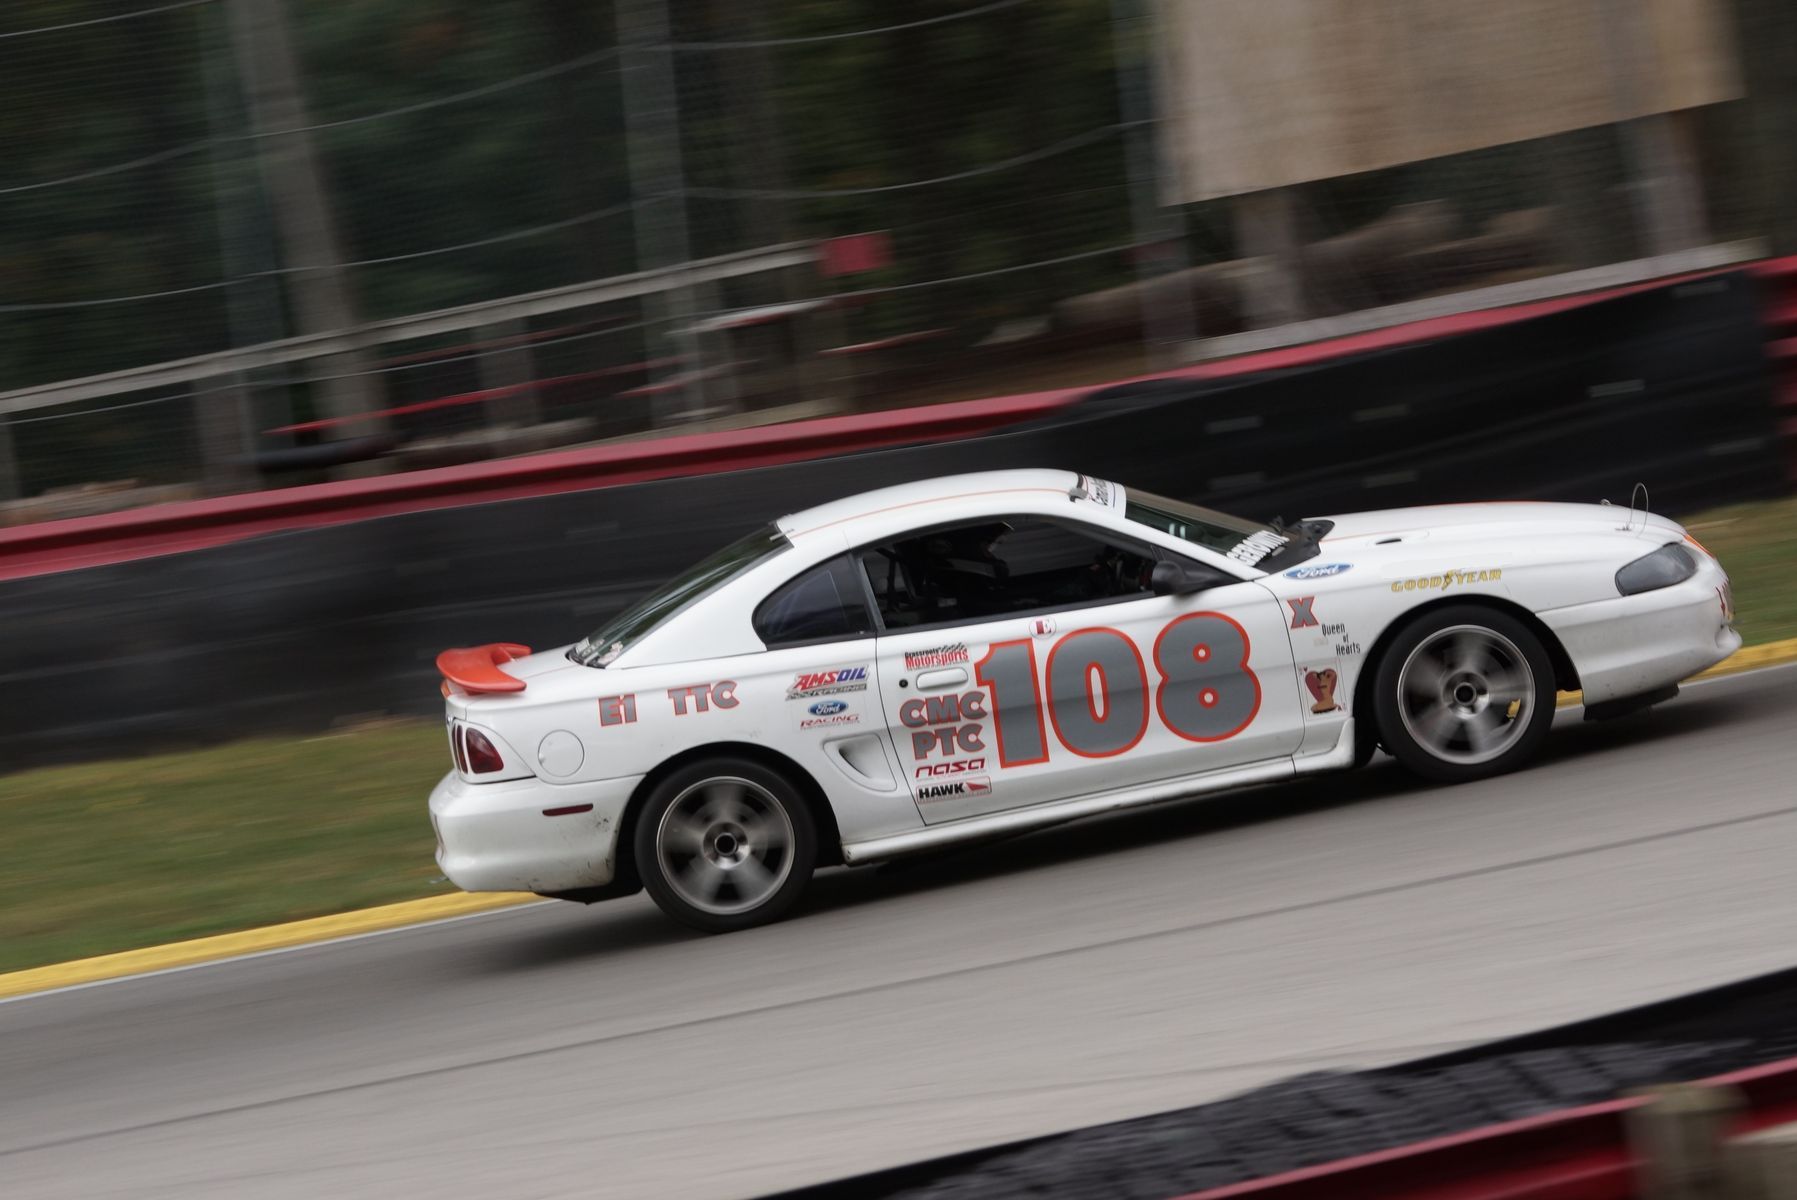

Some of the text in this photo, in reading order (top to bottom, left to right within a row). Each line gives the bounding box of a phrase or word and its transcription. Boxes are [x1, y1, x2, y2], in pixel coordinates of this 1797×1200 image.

[1296, 564, 1340, 579] Ford
[1390, 568, 1502, 593] GOODYEAR
[1286, 596, 1319, 630] X
[1321, 623, 1346, 637] Queen
[1342, 634, 1350, 643] of
[904, 648, 969, 669] Motorsports
[1335, 642, 1361, 656] Hearts
[793, 667, 867, 691] AMSOIL
[974, 610, 1262, 769] 108
[598, 693, 638, 727] E1
[667, 680, 740, 716] TTC
[900, 690, 988, 728] CMC
[800, 713, 860, 727] RACING
[911, 723, 986, 761] PTC
[918, 782, 965, 799] HAWK
